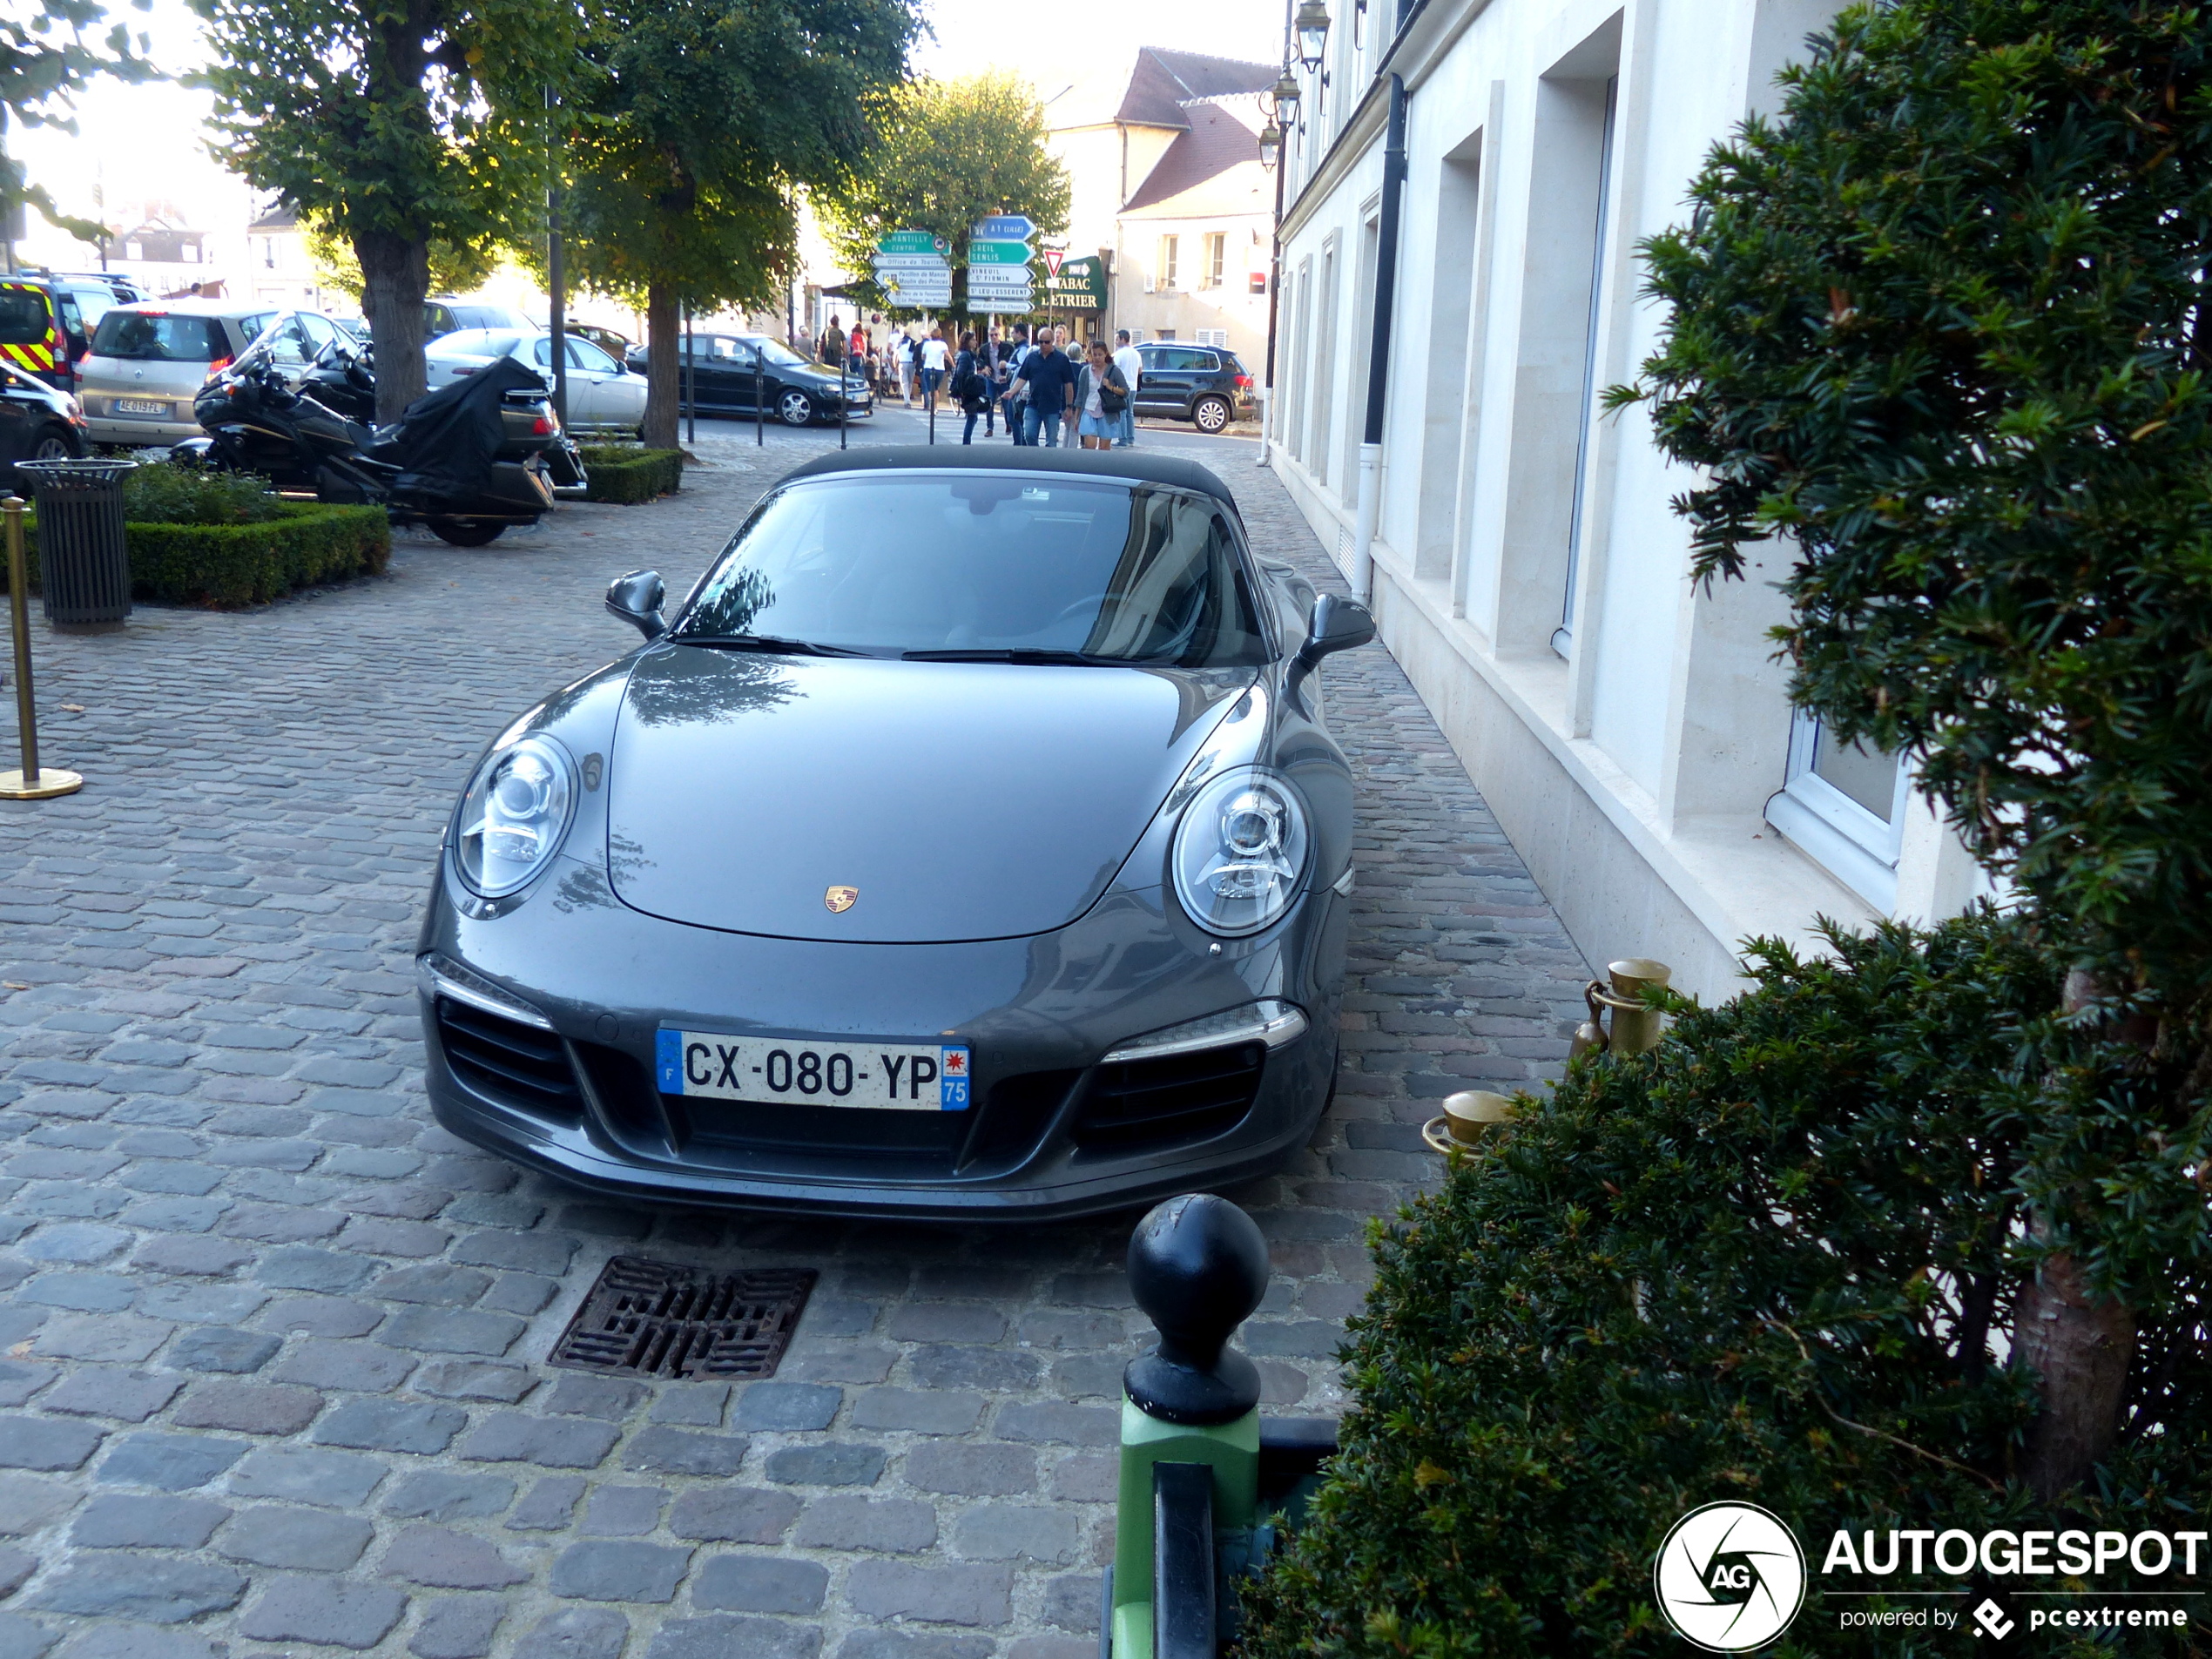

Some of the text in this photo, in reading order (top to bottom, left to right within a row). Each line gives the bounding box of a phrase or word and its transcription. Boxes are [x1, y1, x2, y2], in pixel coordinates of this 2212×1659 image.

[972, 244, 995, 253] CREIL
[1055, 278, 1090, 290] TABAC
[665, 1068, 674, 1081] F
[685, 1042, 938, 1100] CX-080-YP
[944, 1082, 966, 1103] 75
